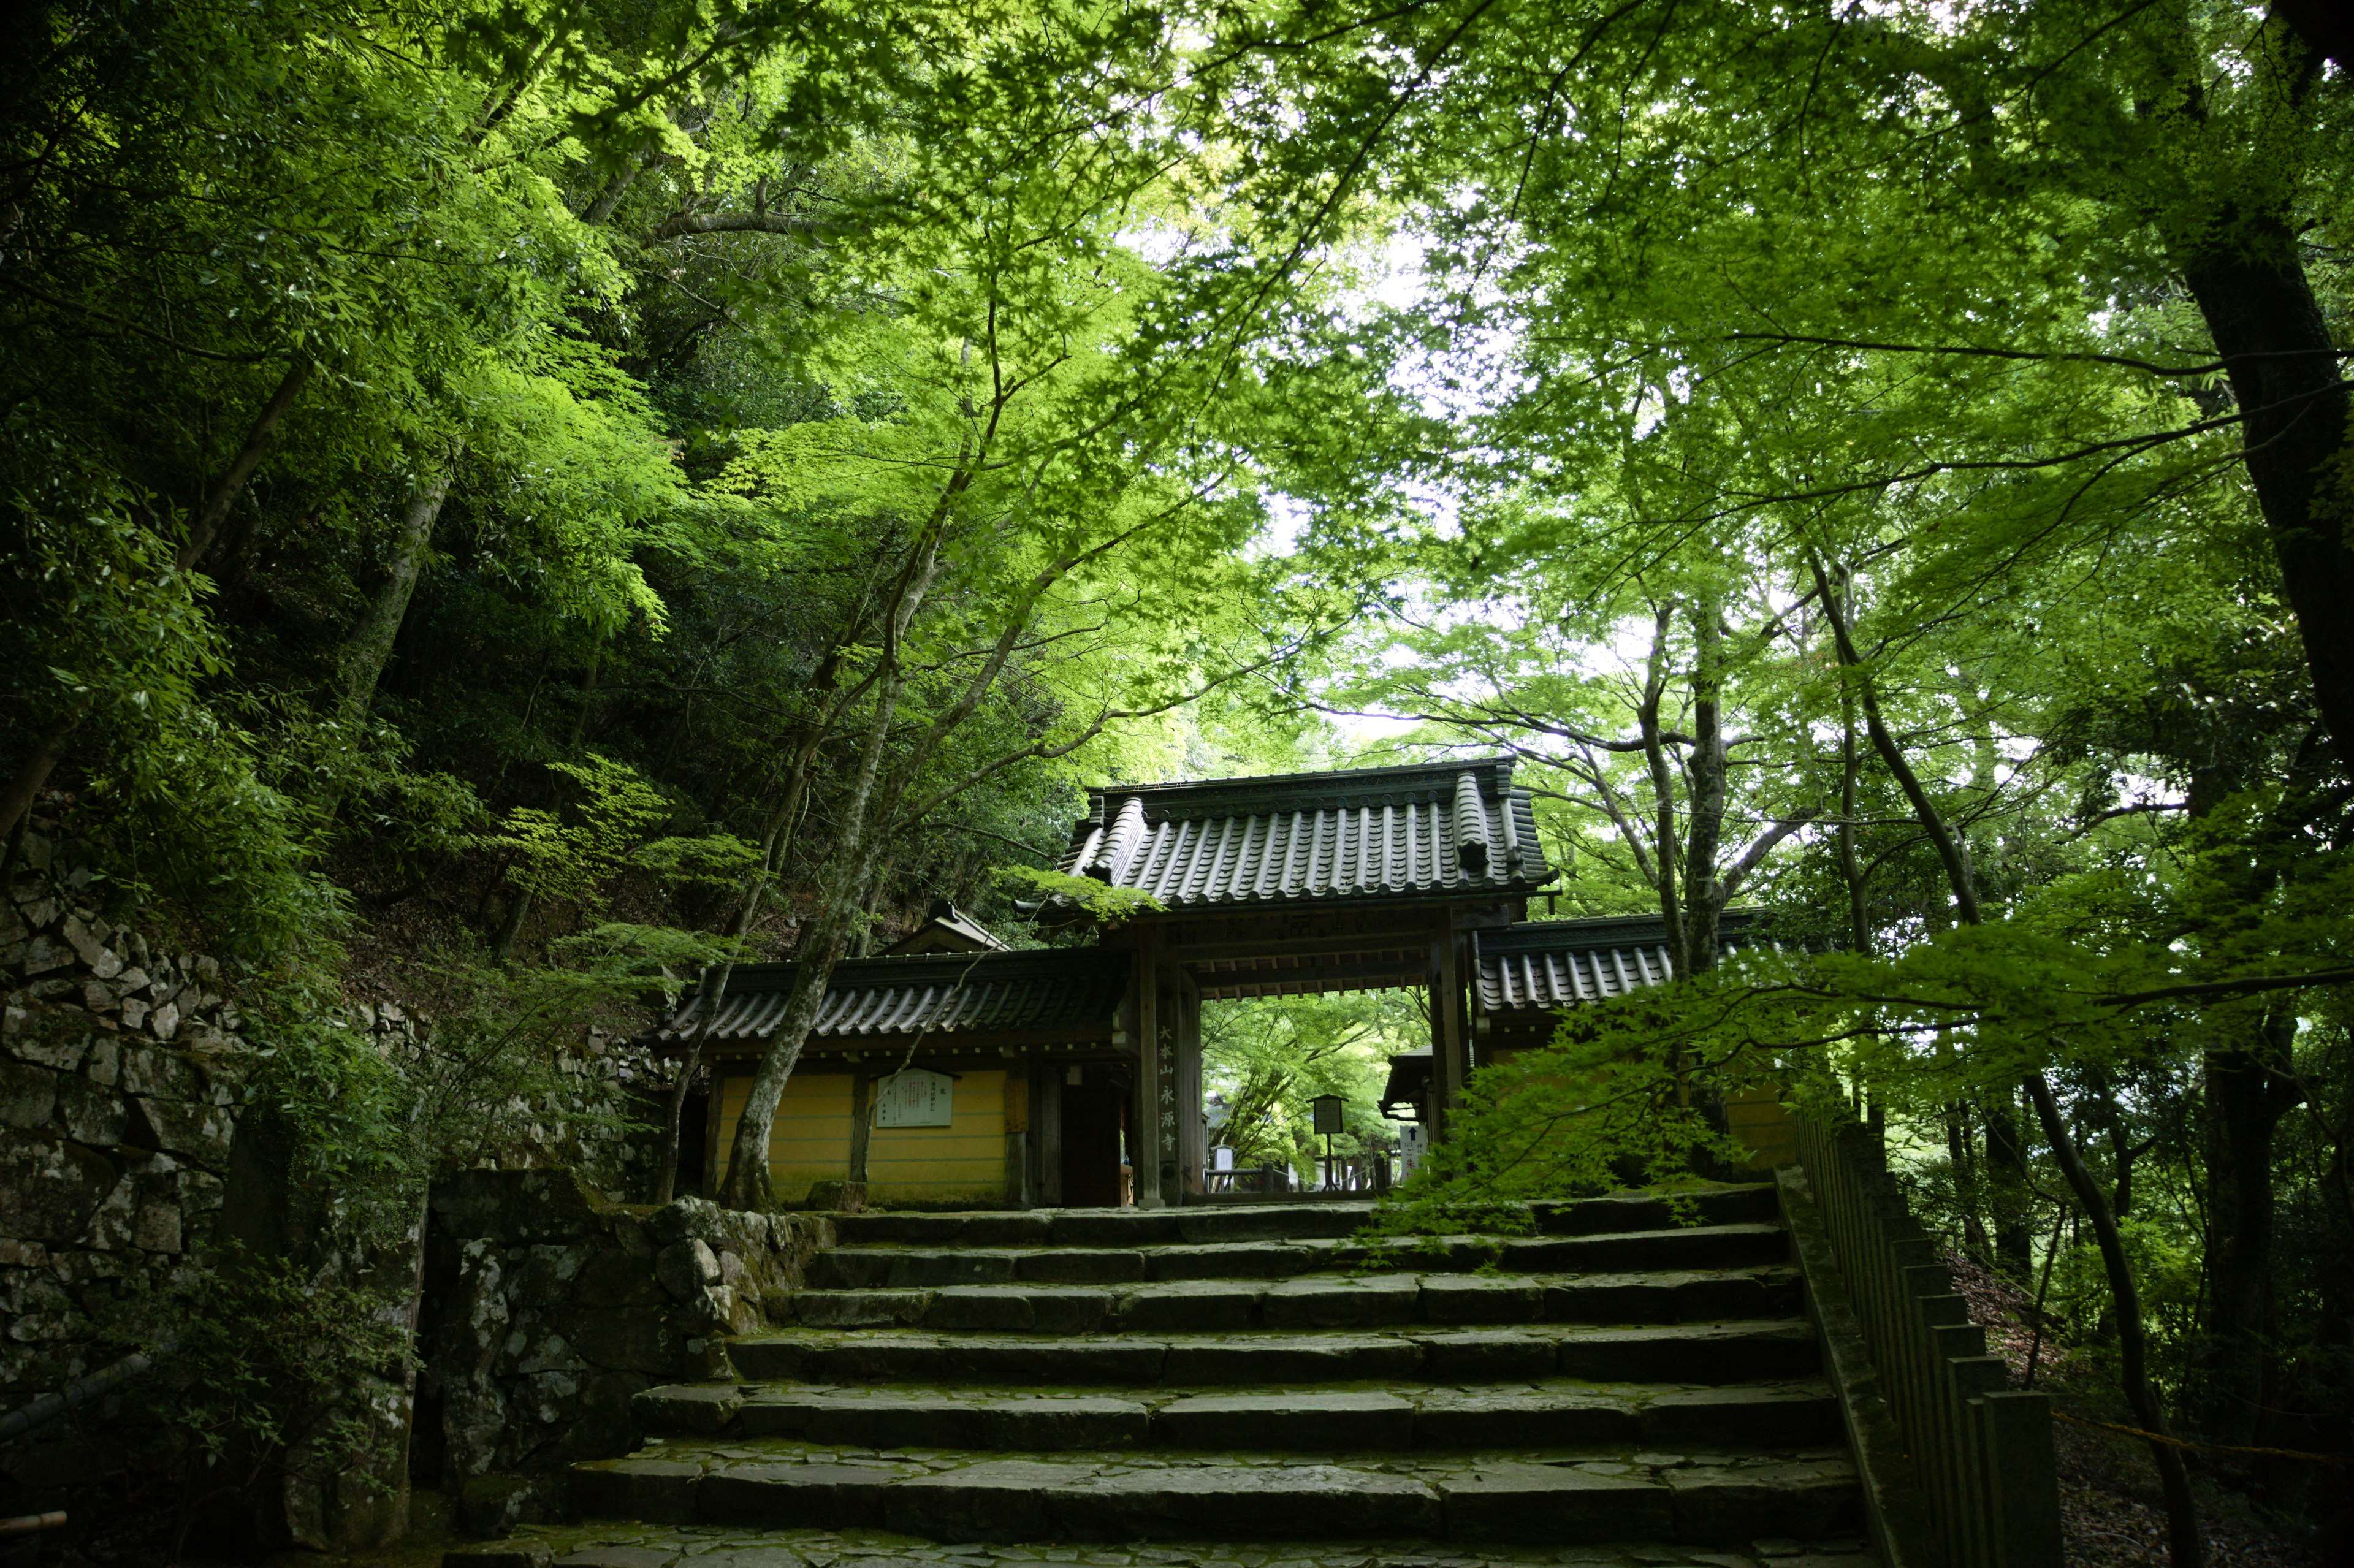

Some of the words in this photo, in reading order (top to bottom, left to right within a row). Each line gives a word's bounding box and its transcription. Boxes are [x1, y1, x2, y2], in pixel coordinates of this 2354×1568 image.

[1159, 1025, 1176, 1152] 大本山永源寺
